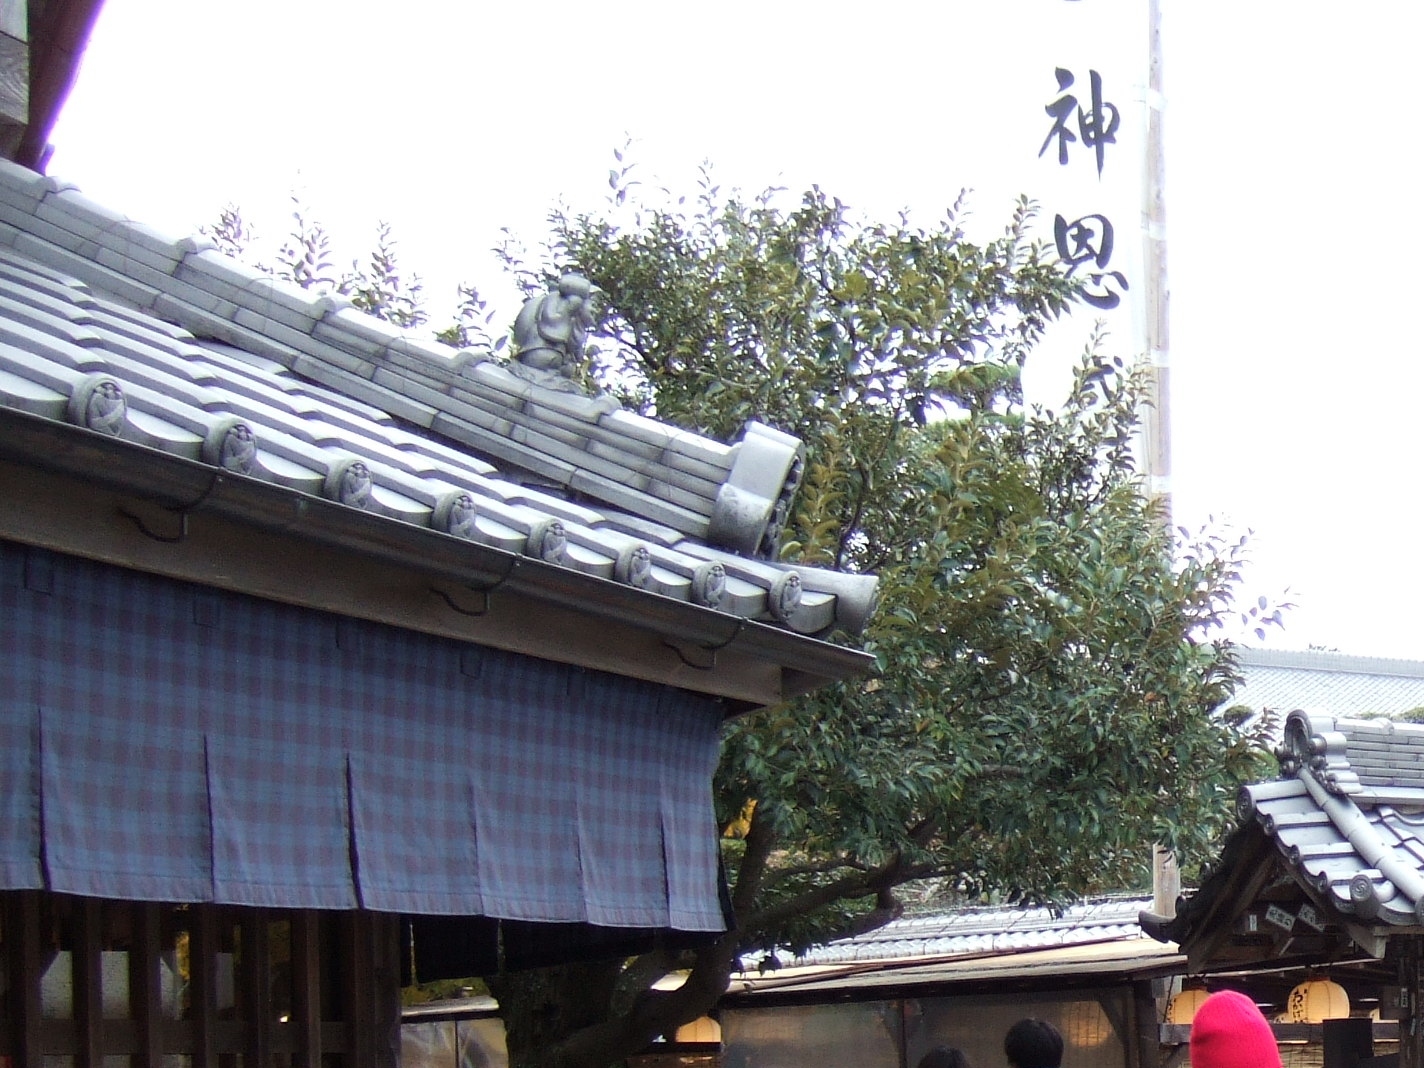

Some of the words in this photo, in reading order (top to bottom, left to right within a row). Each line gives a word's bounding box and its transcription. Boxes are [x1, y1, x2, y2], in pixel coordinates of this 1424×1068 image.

[1038, 0, 1129, 309] 神恩
[1292, 988, 1308, 1023] おかげ
